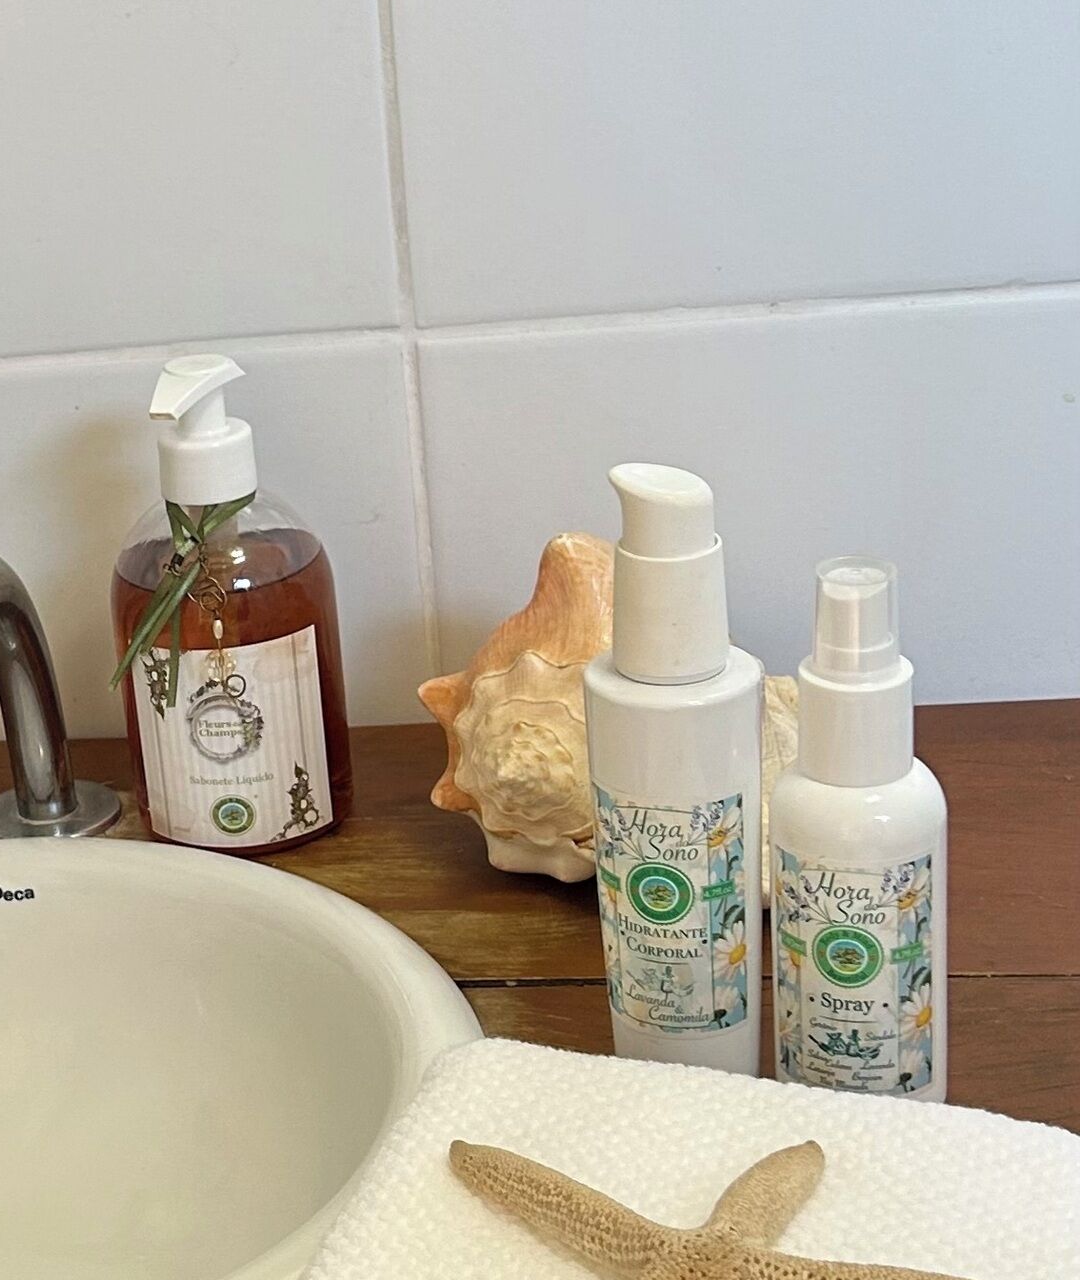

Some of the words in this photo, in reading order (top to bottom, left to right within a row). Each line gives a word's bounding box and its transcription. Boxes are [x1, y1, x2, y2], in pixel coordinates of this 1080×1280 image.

[644, 835, 699, 862] Sono
[809, 871, 871, 902] Hora
[831, 898, 886, 925] Sono
[617, 912, 708, 940] HIDRATANTE
[626, 935, 703, 959] CORPORAL
[625, 983, 676, 1008] Lavanda
[820, 991, 875, 1016] Spray
